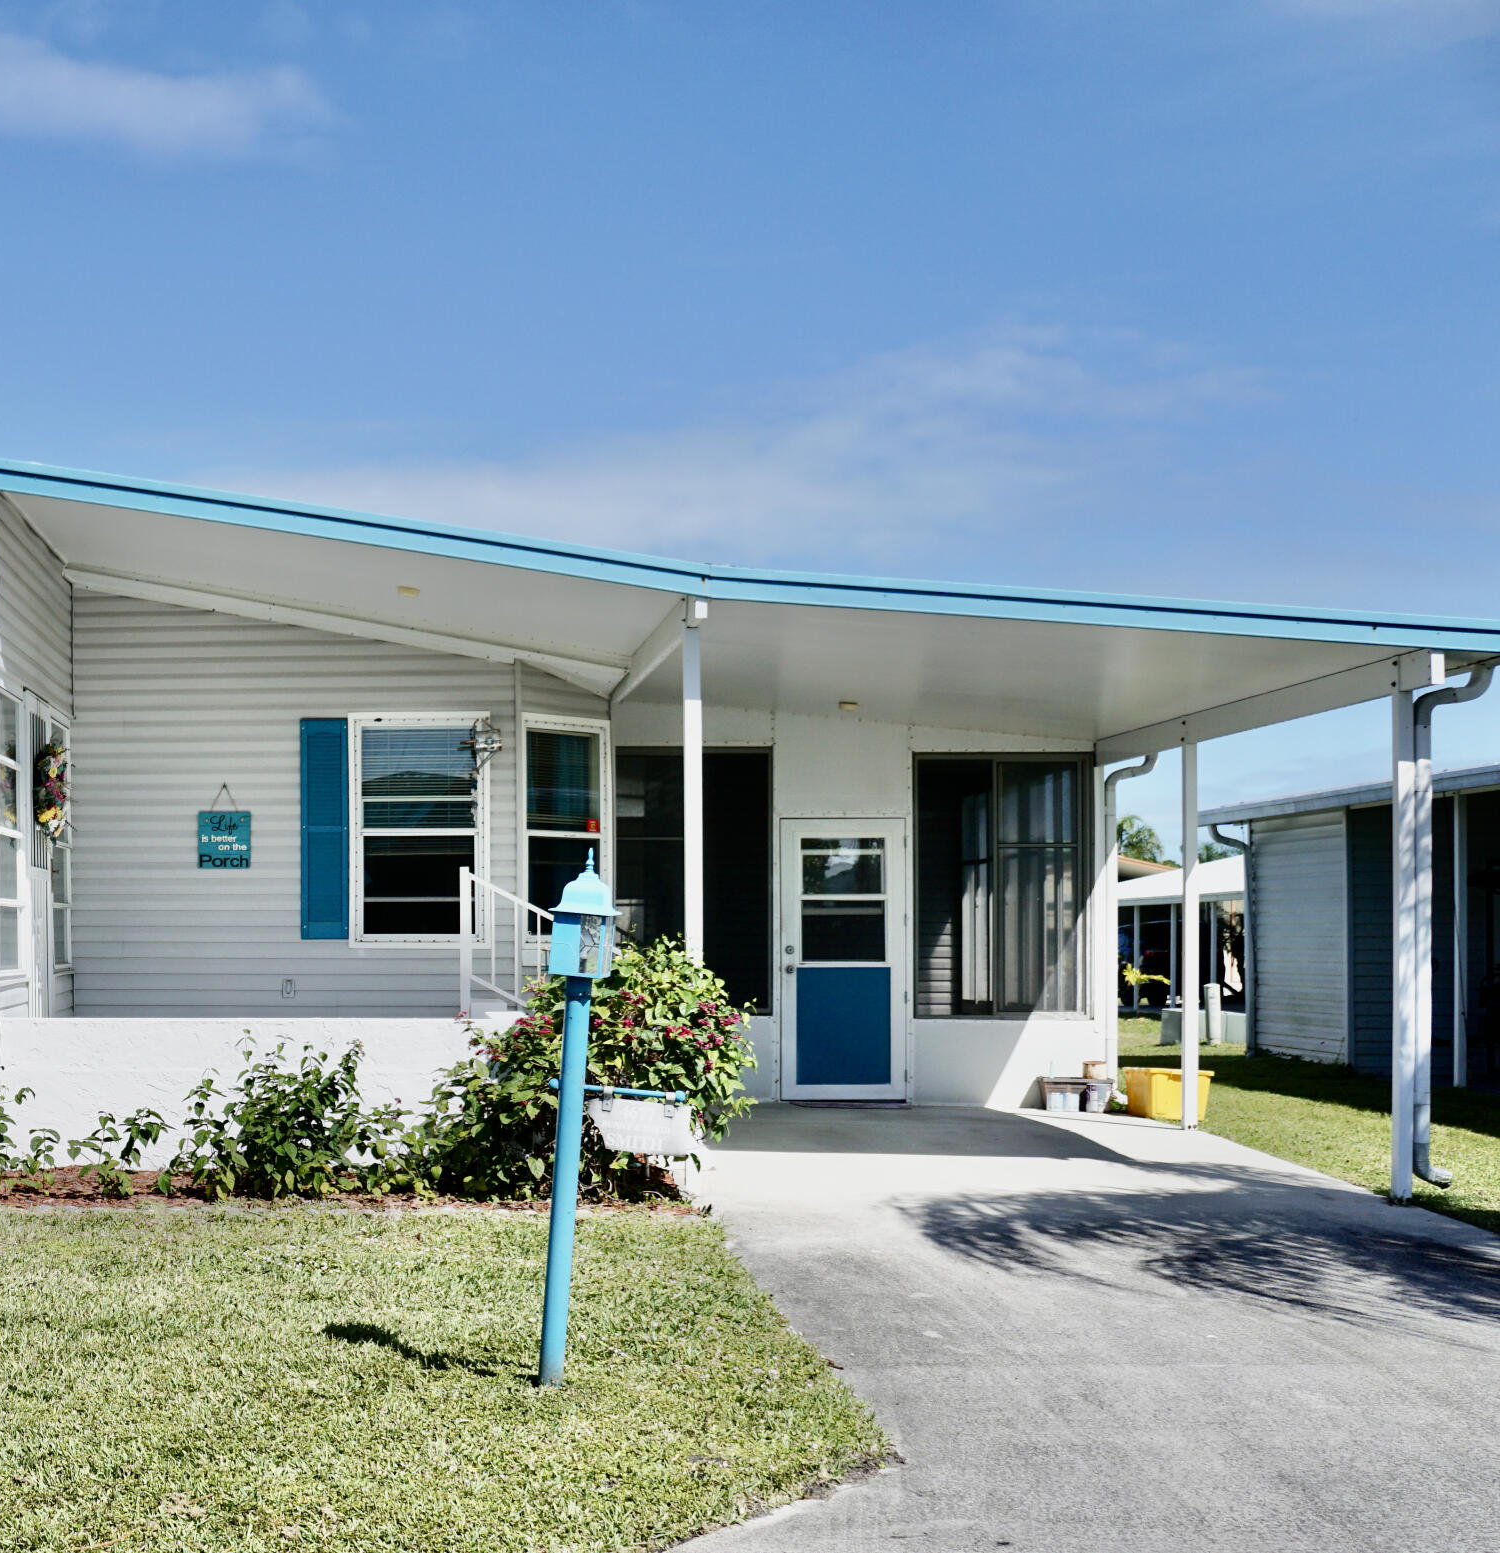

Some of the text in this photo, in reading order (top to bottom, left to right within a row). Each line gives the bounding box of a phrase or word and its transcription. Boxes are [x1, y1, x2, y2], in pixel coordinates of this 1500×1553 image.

[210, 815, 238, 835] Life
[201, 834, 237, 843] is better
[232, 843, 247, 851] the
[199, 854, 249, 868] Porch
[606, 1132, 662, 1150] SMITH
